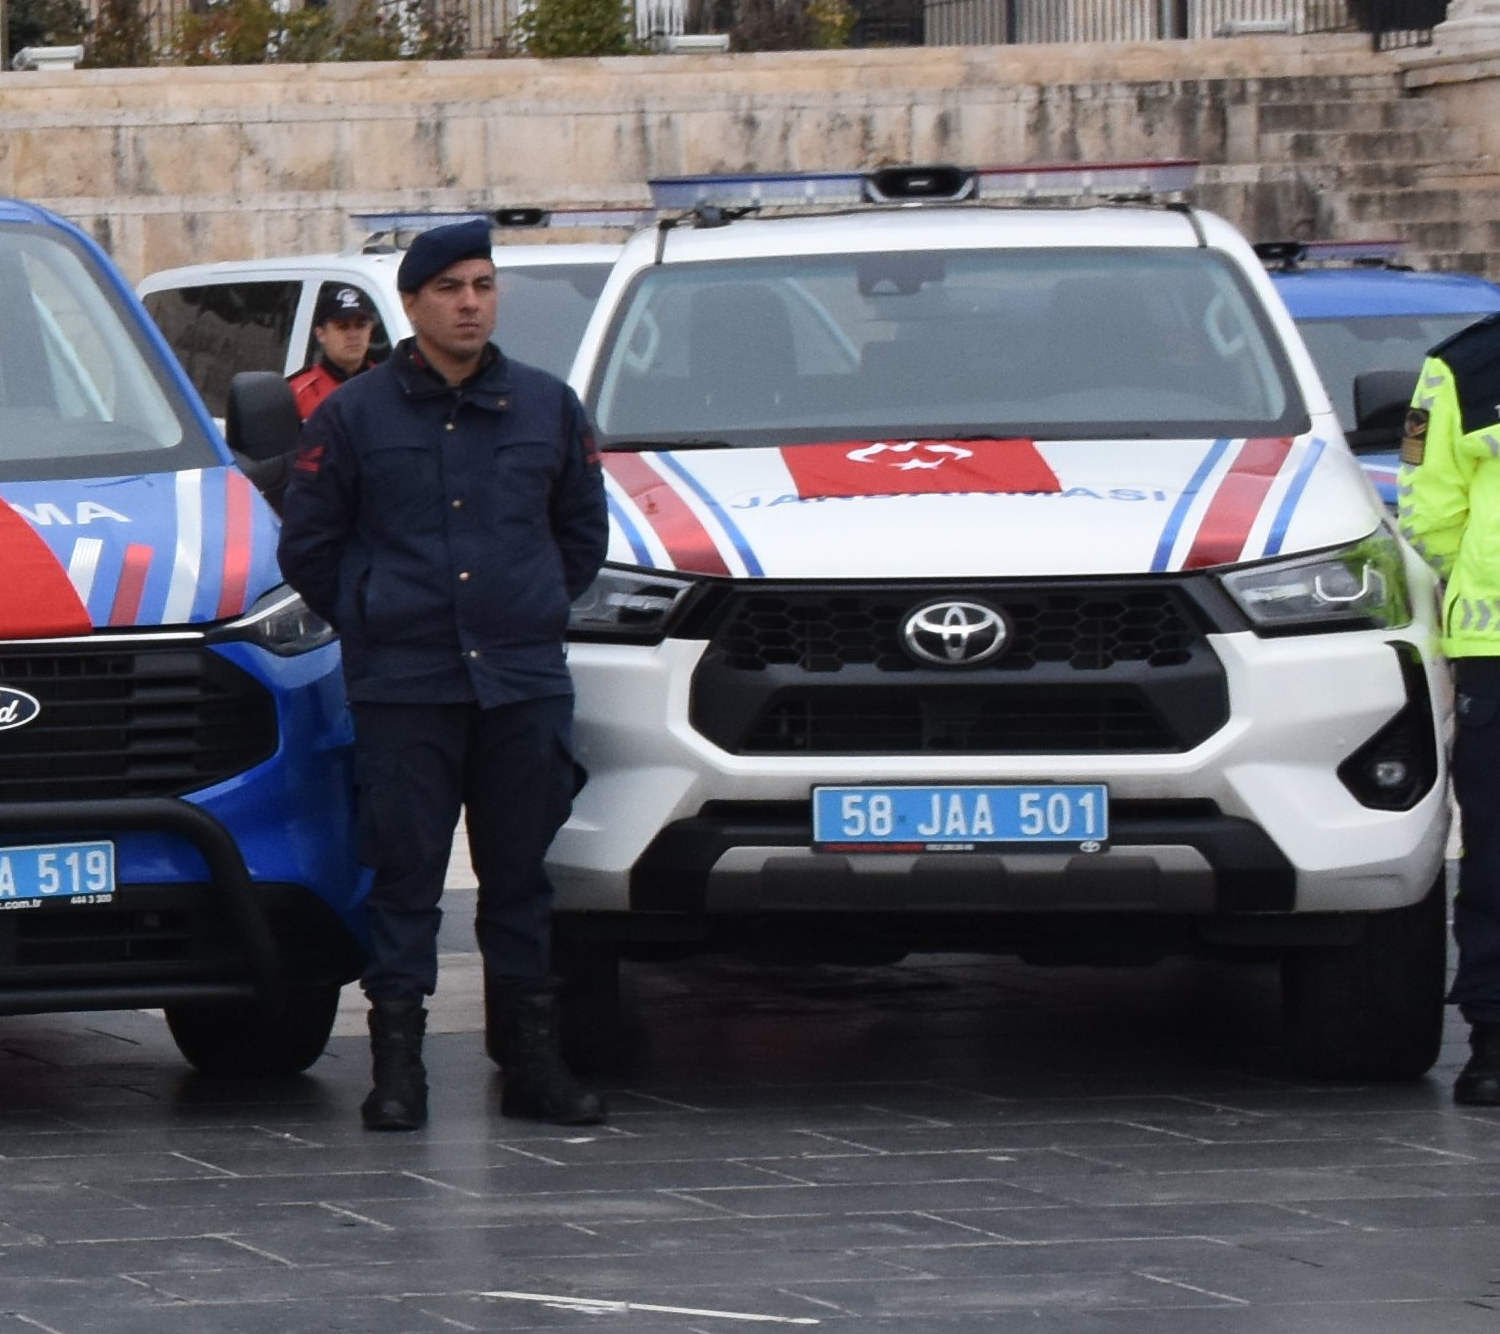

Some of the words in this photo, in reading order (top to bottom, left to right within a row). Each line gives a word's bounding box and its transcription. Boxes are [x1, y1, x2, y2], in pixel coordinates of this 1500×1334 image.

[841, 794, 893, 836] 58
[917, 793, 995, 836] JAA
[1019, 792, 1096, 835] 501
[37, 850, 108, 894] 519
